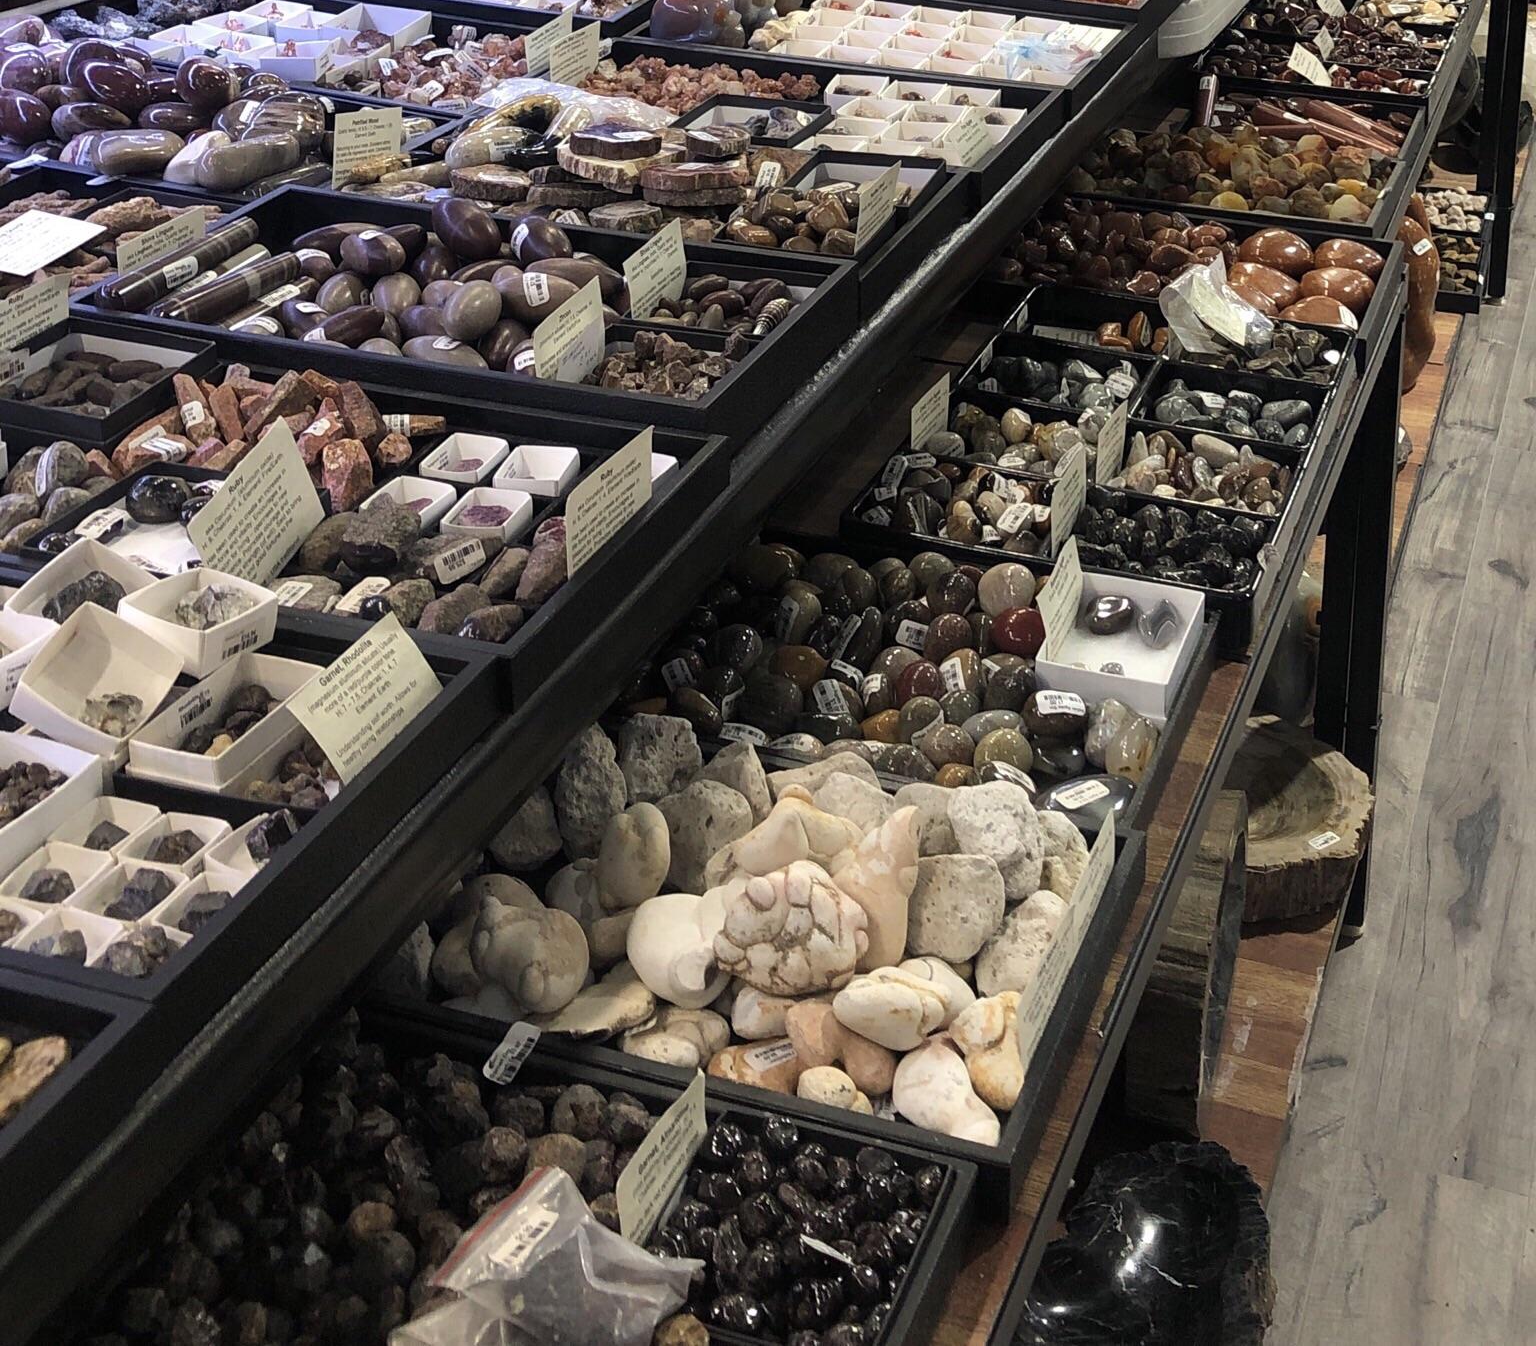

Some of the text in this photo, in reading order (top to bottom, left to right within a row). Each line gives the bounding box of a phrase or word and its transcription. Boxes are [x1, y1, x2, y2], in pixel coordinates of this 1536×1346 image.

[228, 475, 244, 495] Ruby
[206, 553, 216, 565] Has
[215, 539, 227, 554] been
[227, 524, 239, 540] used
[244, 502, 258, 520] create
[263, 474, 282, 496] increase
[280, 499, 289, 512] and
[205, 524, 214, 535] aka
[230, 550, 238, 559] for
[278, 489, 288, 502] new
[229, 537, 238, 550] and
[319, 640, 372, 686] Garnet, Rhodolite
[339, 663, 363, 686] aluminum
[378, 632, 398, 650] Usually
[324, 700, 339, 712] more
[371, 658, 384, 671] color
[376, 680, 392, 695] Earth
[336, 723, 372, 758] Understanding
[394, 686, 411, 702] Allows
[409, 679, 417, 688] for
[342, 749, 362, 768] healthy
